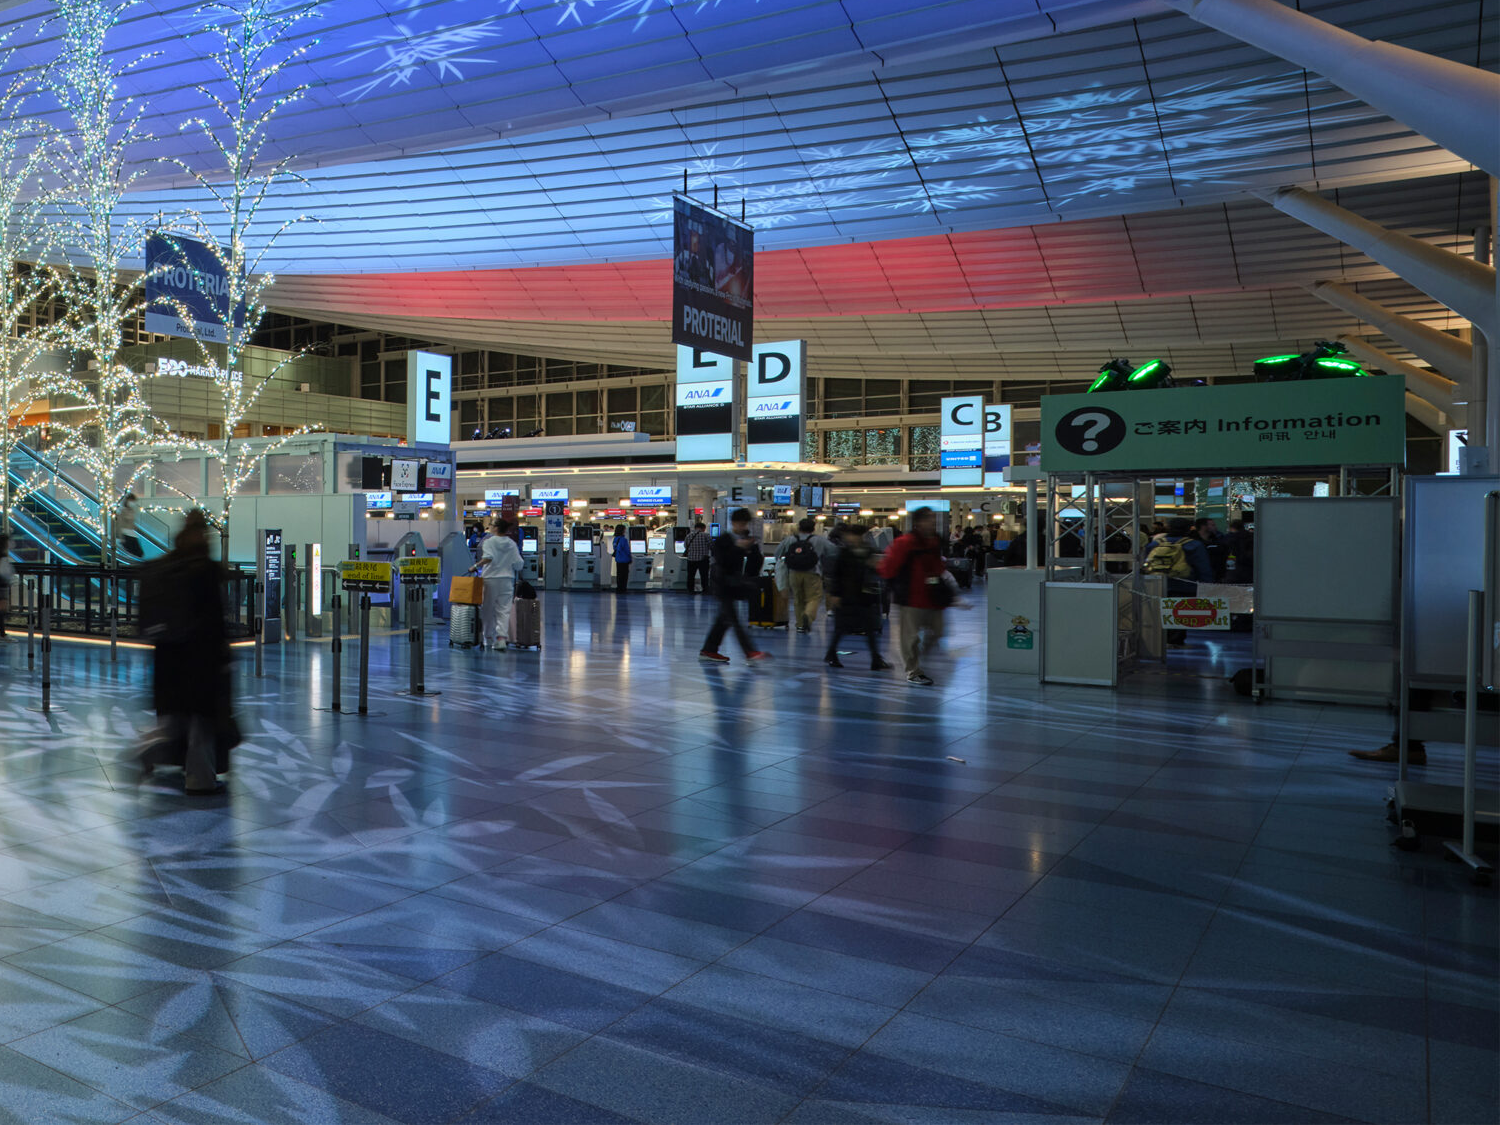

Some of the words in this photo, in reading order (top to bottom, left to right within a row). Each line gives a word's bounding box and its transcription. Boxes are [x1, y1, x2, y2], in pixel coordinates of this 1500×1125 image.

[153, 261, 233, 298] PROTERIA
[683, 304, 745, 347] PROTERIAL
[758, 352, 791, 384] D
[425, 369, 441, 422] E
[685, 389, 710, 399] ANA
[756, 402, 779, 411] ANA
[951, 403, 974, 425] C
[985, 411, 1002, 433] B
[1134, 418, 1207, 436] ご案内
[1218, 412, 1381, 432] Information
[1304, 429, 1336, 440] 안내
[732, 486, 743, 501] E
[981, 502, 991, 512] C
[1162, 614, 1198, 627] Keep
[1204, 614, 1229, 626] out
